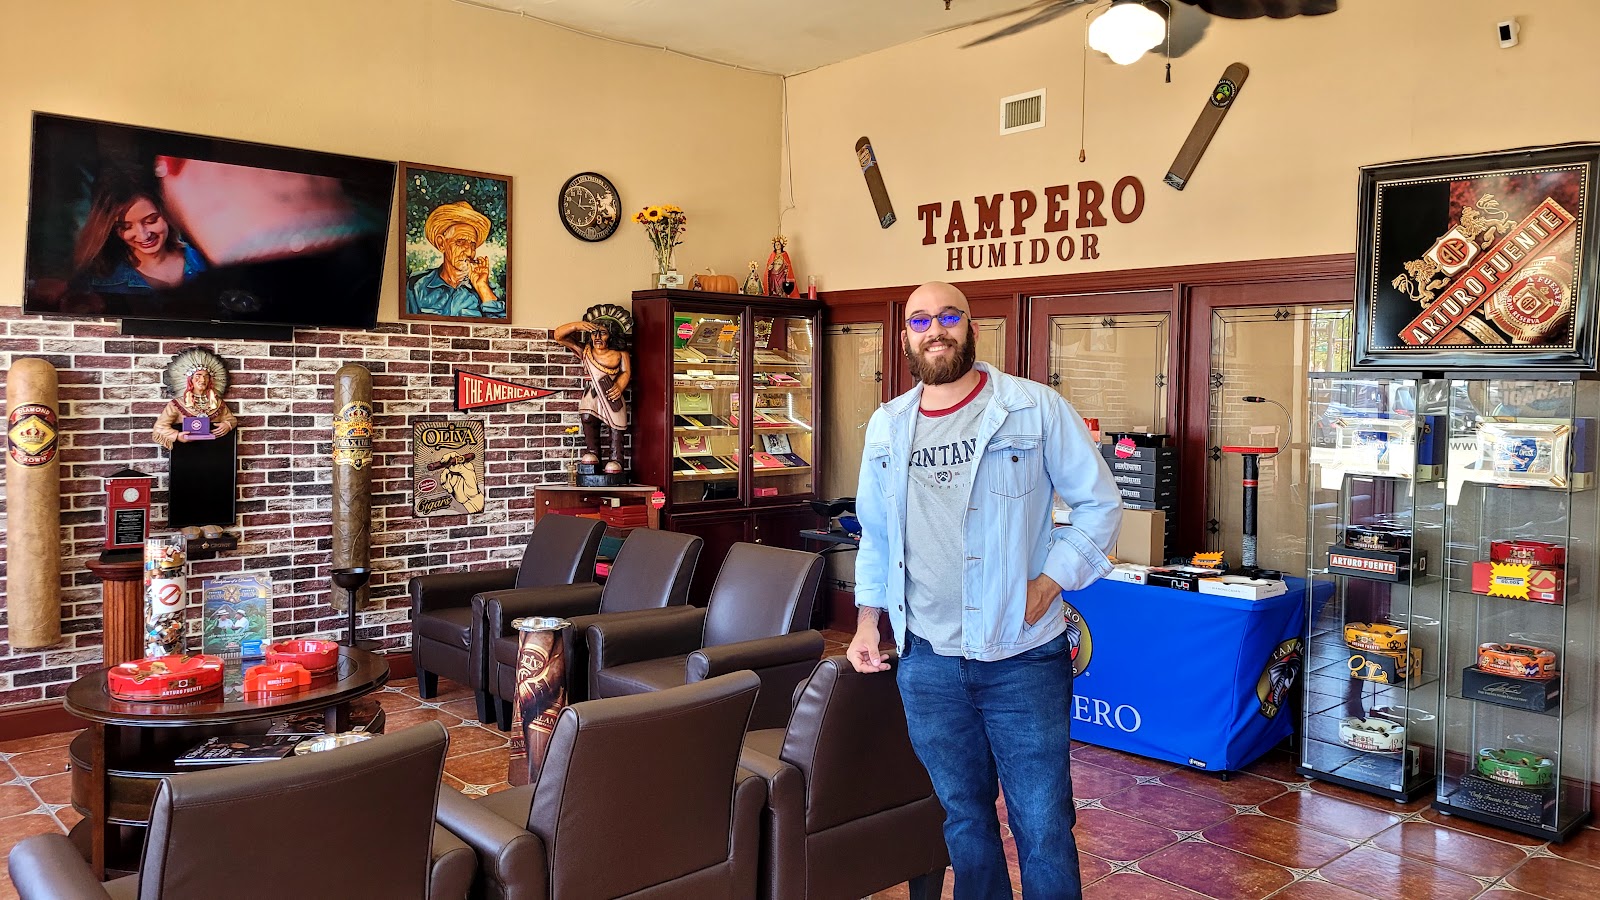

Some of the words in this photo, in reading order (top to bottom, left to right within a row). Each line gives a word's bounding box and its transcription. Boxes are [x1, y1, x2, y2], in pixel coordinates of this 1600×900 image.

[918, 175, 1145, 245] TAMPERO
[946, 233, 1100, 272] HUMIDOR
[1411, 275, 1486, 345] ARTURO
[1480, 206, 1564, 284] FUENTE
[1512, 310, 1540, 324] RESERVA
[463, 377, 483, 405] THE
[485, 382, 538, 402] AMERICAN
[421, 424, 477, 447] OLIVA
[417, 497, 452, 515] Cigars
[1332, 556, 1362, 567] ARTURO
[1363, 559, 1393, 572] FUENTE
[162, 687, 183, 696] ARTURO
[183, 685, 202, 693] FUENTE
[1072, 694, 1142, 733] ERO
